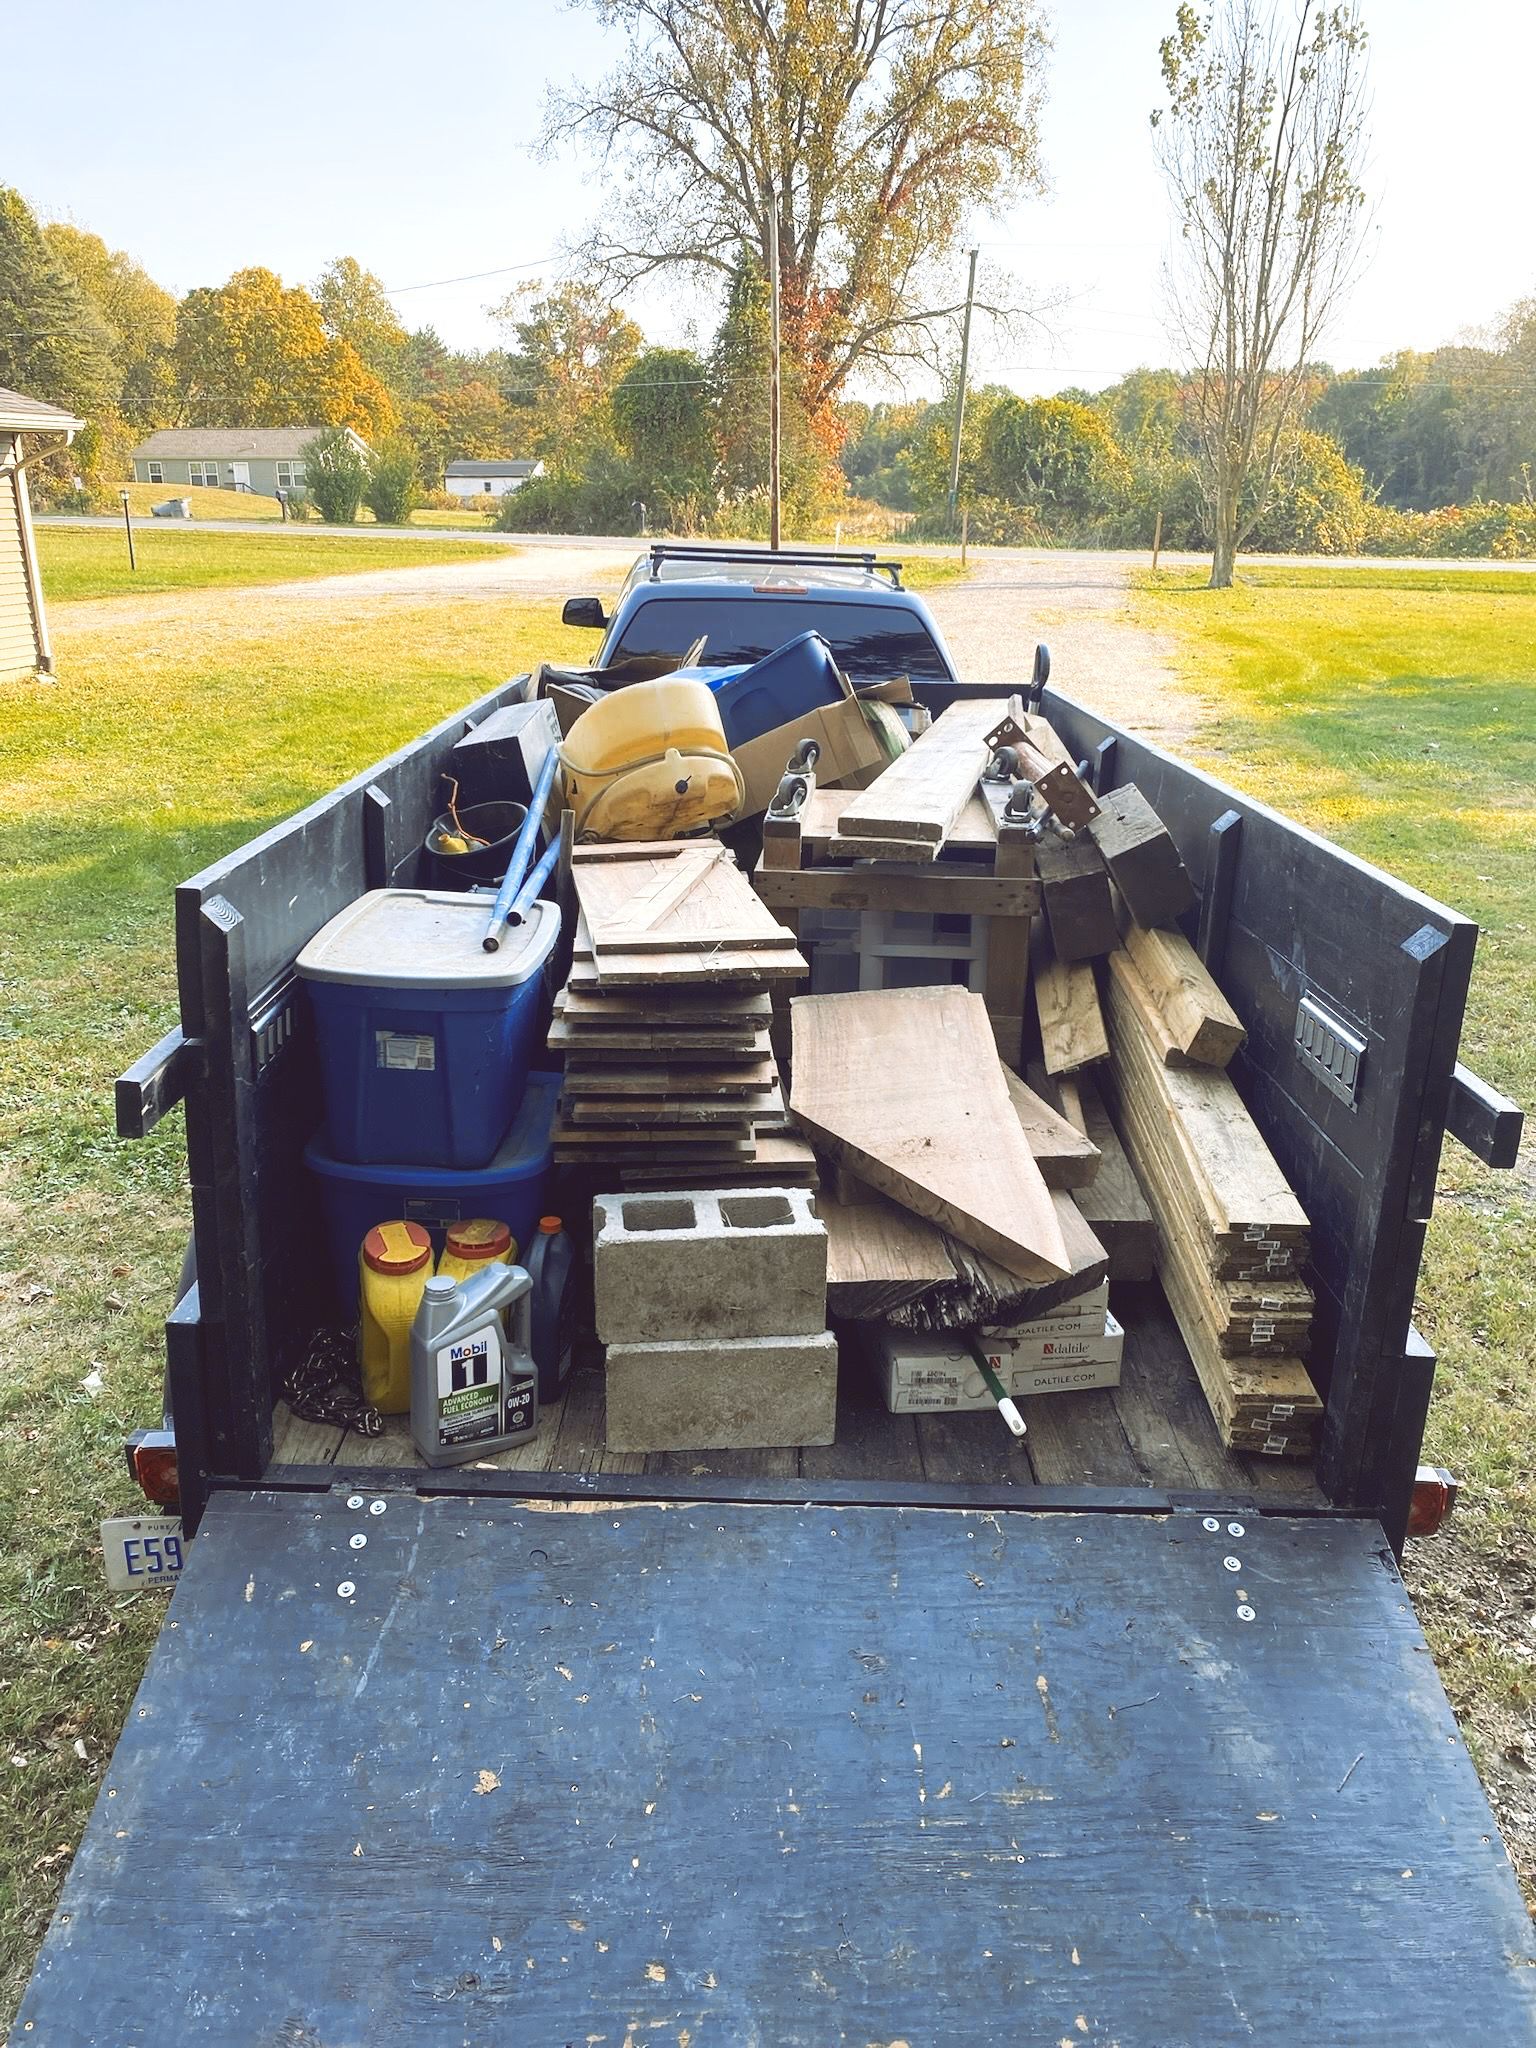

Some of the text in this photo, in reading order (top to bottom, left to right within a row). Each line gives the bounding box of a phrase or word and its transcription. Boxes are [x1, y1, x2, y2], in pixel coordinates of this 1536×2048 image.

[451, 1341, 487, 1359] Mobil
[461, 1359, 475, 1387] 1
[443, 1391, 479, 1408] ADVANCED
[443, 1404, 459, 1415] FUEL
[460, 1394, 494, 1411] ECONOMY
[508, 1393, 530, 1408] 0W-20
[123, 1536, 183, 1575] E59
[148, 1574, 181, 1584] PERMA
